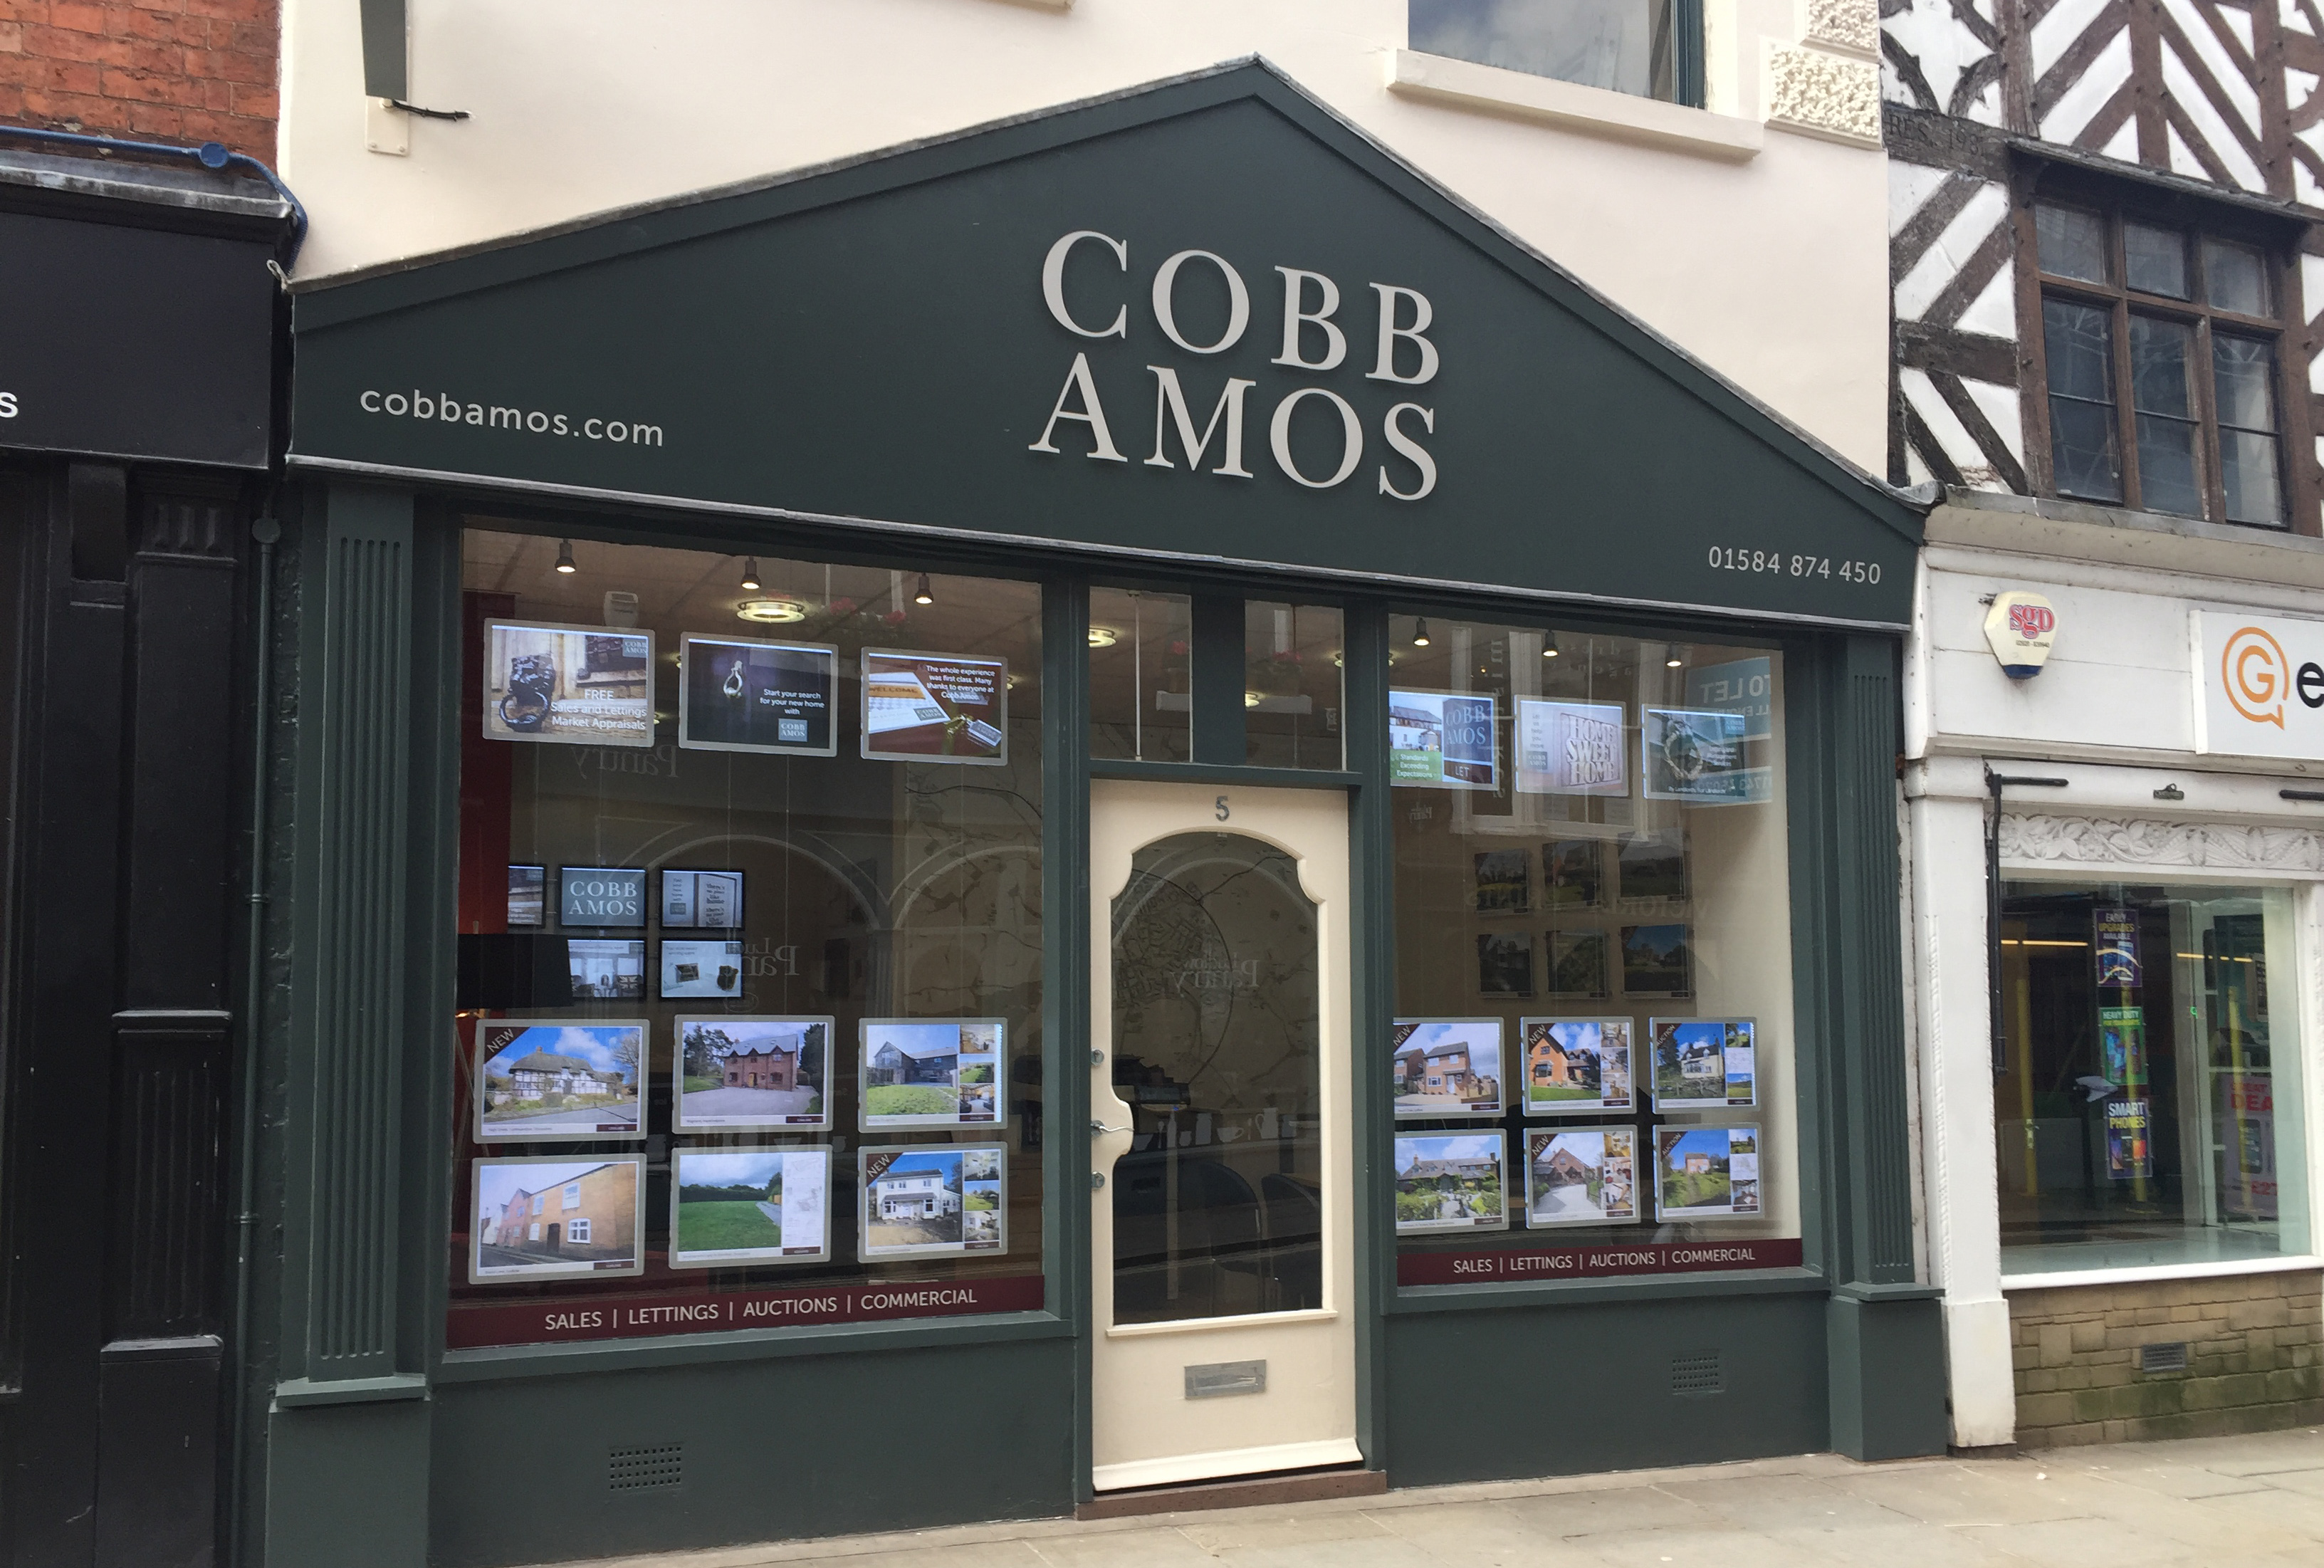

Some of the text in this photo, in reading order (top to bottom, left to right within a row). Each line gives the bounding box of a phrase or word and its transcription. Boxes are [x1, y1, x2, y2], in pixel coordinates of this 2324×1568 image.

[1042, 230, 1439, 385] COBB
[360, 389, 663, 446] cobbamos.com
[1028, 352, 1437, 500] AMOS
[1709, 546, 1880, 584] 01584 874 450
[940, 666, 960, 674] whole
[961, 668, 995, 677] experience
[975, 677, 993, 686] Many
[585, 689, 614, 701] FREE
[763, 689, 780, 697] Start
[958, 686, 987, 695] everyone
[550, 701, 647, 718] Sales and Lettings
[805, 700, 825, 709] home
[552, 716, 646, 730] Market Appraisals
[1445, 704, 1486, 727] COBB
[1447, 726, 1487, 746] AMOS
[1569, 716, 1617, 743] HOME
[1400, 753, 1429, 762] Standards
[1566, 738, 1616, 763] SWEET
[1396, 770, 1433, 778] Expectations
[1400, 761, 1430, 770] Exceeding
[1455, 765, 1470, 778] LET
[1569, 761, 1616, 785] HOME
[1215, 795, 1230, 822] 5
[569, 881, 637, 897] COBB
[568, 899, 637, 916] AMOS
[486, 1028, 515, 1053] NEW
[1393, 1025, 1411, 1047] NEW
[1529, 1024, 1547, 1045] NEW
[2108, 1102, 2145, 1117] SMART
[2109, 1116, 2146, 1129] PHONES
[1532, 1134, 1550, 1156] NEW
[1661, 1132, 1682, 1156] AUCTION
[867, 1153, 891, 1178] NEW
[1452, 1248, 1756, 1274] SALES LETTINGS AUCTIONS COMMERCIAL
[545, 1288, 978, 1331] SALES LETTINGS AUCTIONS COMMERCIAL
